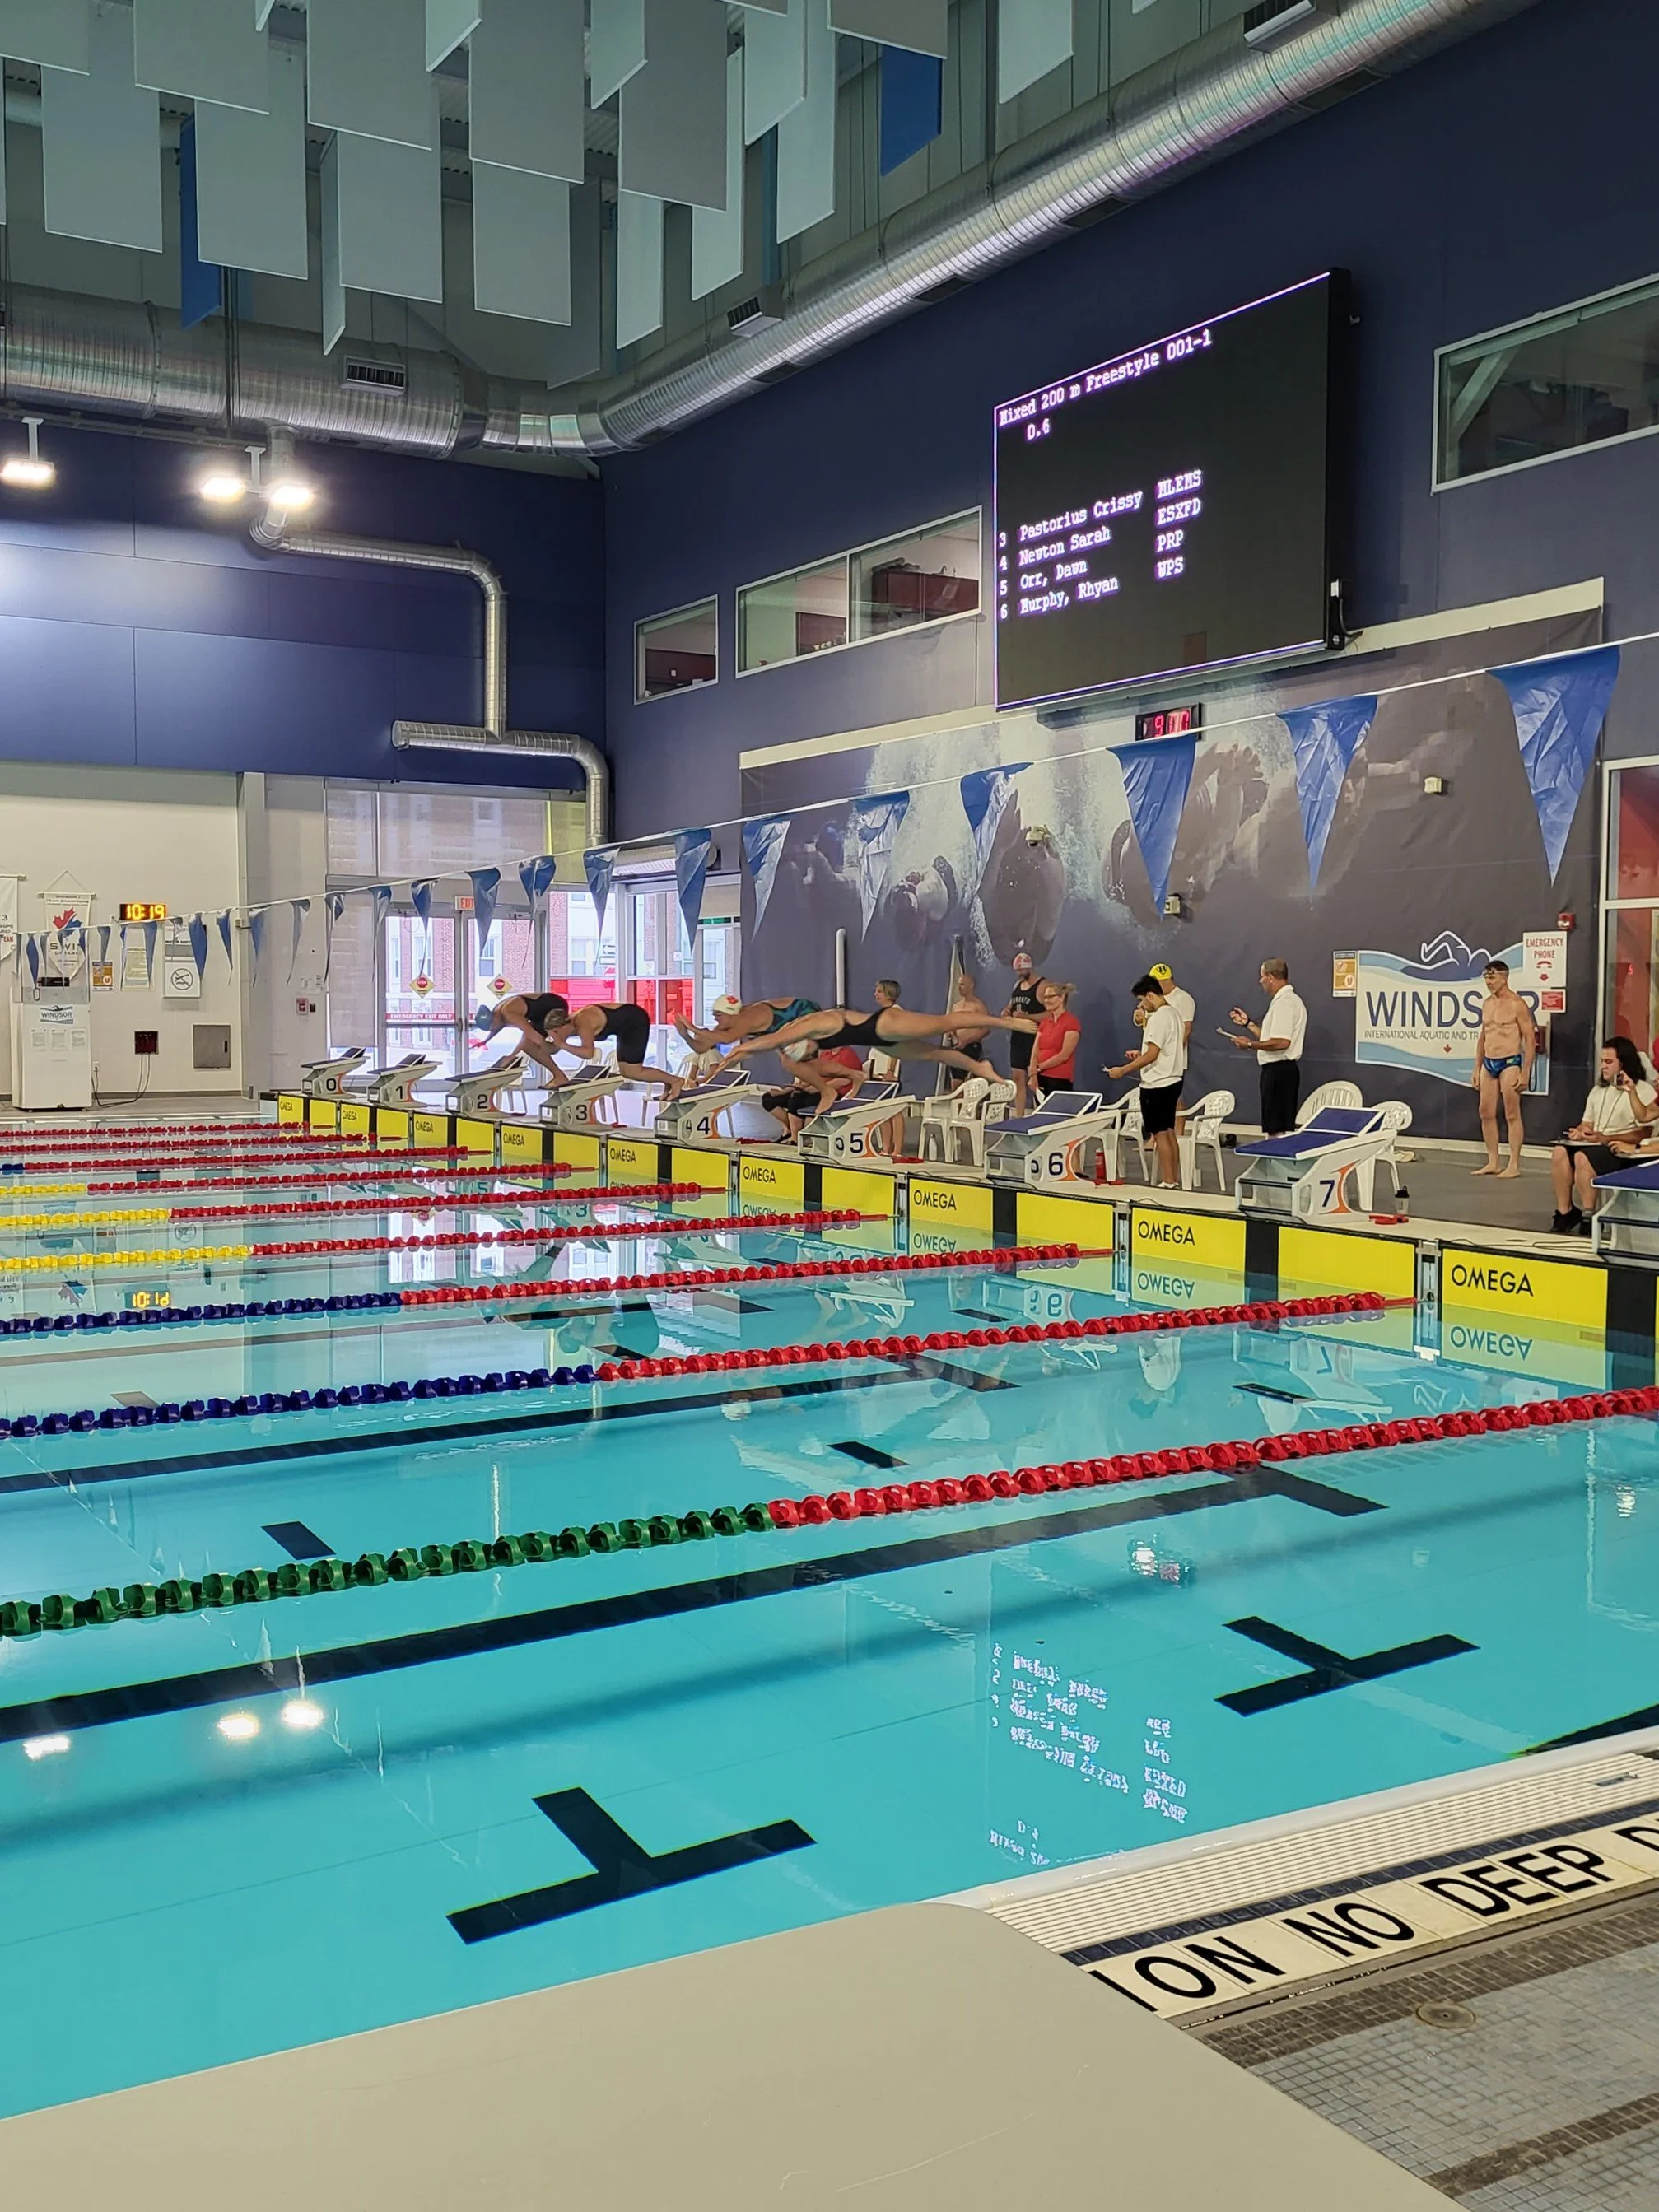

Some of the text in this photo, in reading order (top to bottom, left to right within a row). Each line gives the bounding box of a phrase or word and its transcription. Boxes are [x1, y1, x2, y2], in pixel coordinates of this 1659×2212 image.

[999, 328, 1212, 426] Mixed 200 m Freestyle 001-1
[1027, 418, 1050, 440] 0.6
[999, 532, 1007, 547] 3
[1019, 509, 1088, 542] Pastorius
[1093, 491, 1143, 519] Crissy
[999, 497, 1202, 571] 4 Newton Sarah ESXFD
[1000, 529, 1184, 596] 5 Orr, Dawn PRP
[1000, 604, 1008, 619] 6
[1078, 577, 1118, 599] Rhyan
[126, 904, 165, 920] 10:19
[1526, 938, 1563, 948] EMERGENCY
[1534, 950, 1555, 959] PHONE
[1365, 990, 1540, 1028] WINDSR
[1364, 1030, 1419, 1039] INTERNATIONAL
[1419, 1031, 1451, 1041] AQUATIC
[1451, 1031, 1467, 1040] AND
[326, 1078, 336, 1091] 0
[395, 1085, 403, 1100] 1
[477, 1094, 488, 1109] 2
[576, 1105, 587, 1120] 3
[697, 1116, 711, 1135] 4
[503, 1132, 525, 1147] OMEGA
[850, 1133, 864, 1153] 5
[609, 1148, 637, 1163] OMEGA
[1048, 1152, 1063, 1176] 6
[743, 1166, 776, 1185] OMEGA
[913, 1189, 958, 1212] OMEGA
[1319, 1179, 1335, 1208] 7
[1137, 1220, 1196, 1246] OMEGA
[1451, 1264, 1535, 1298] OMEGA
[1282, 1902, 1415, 1958] NO
[1417, 1844, 1615, 1918] DEEP
